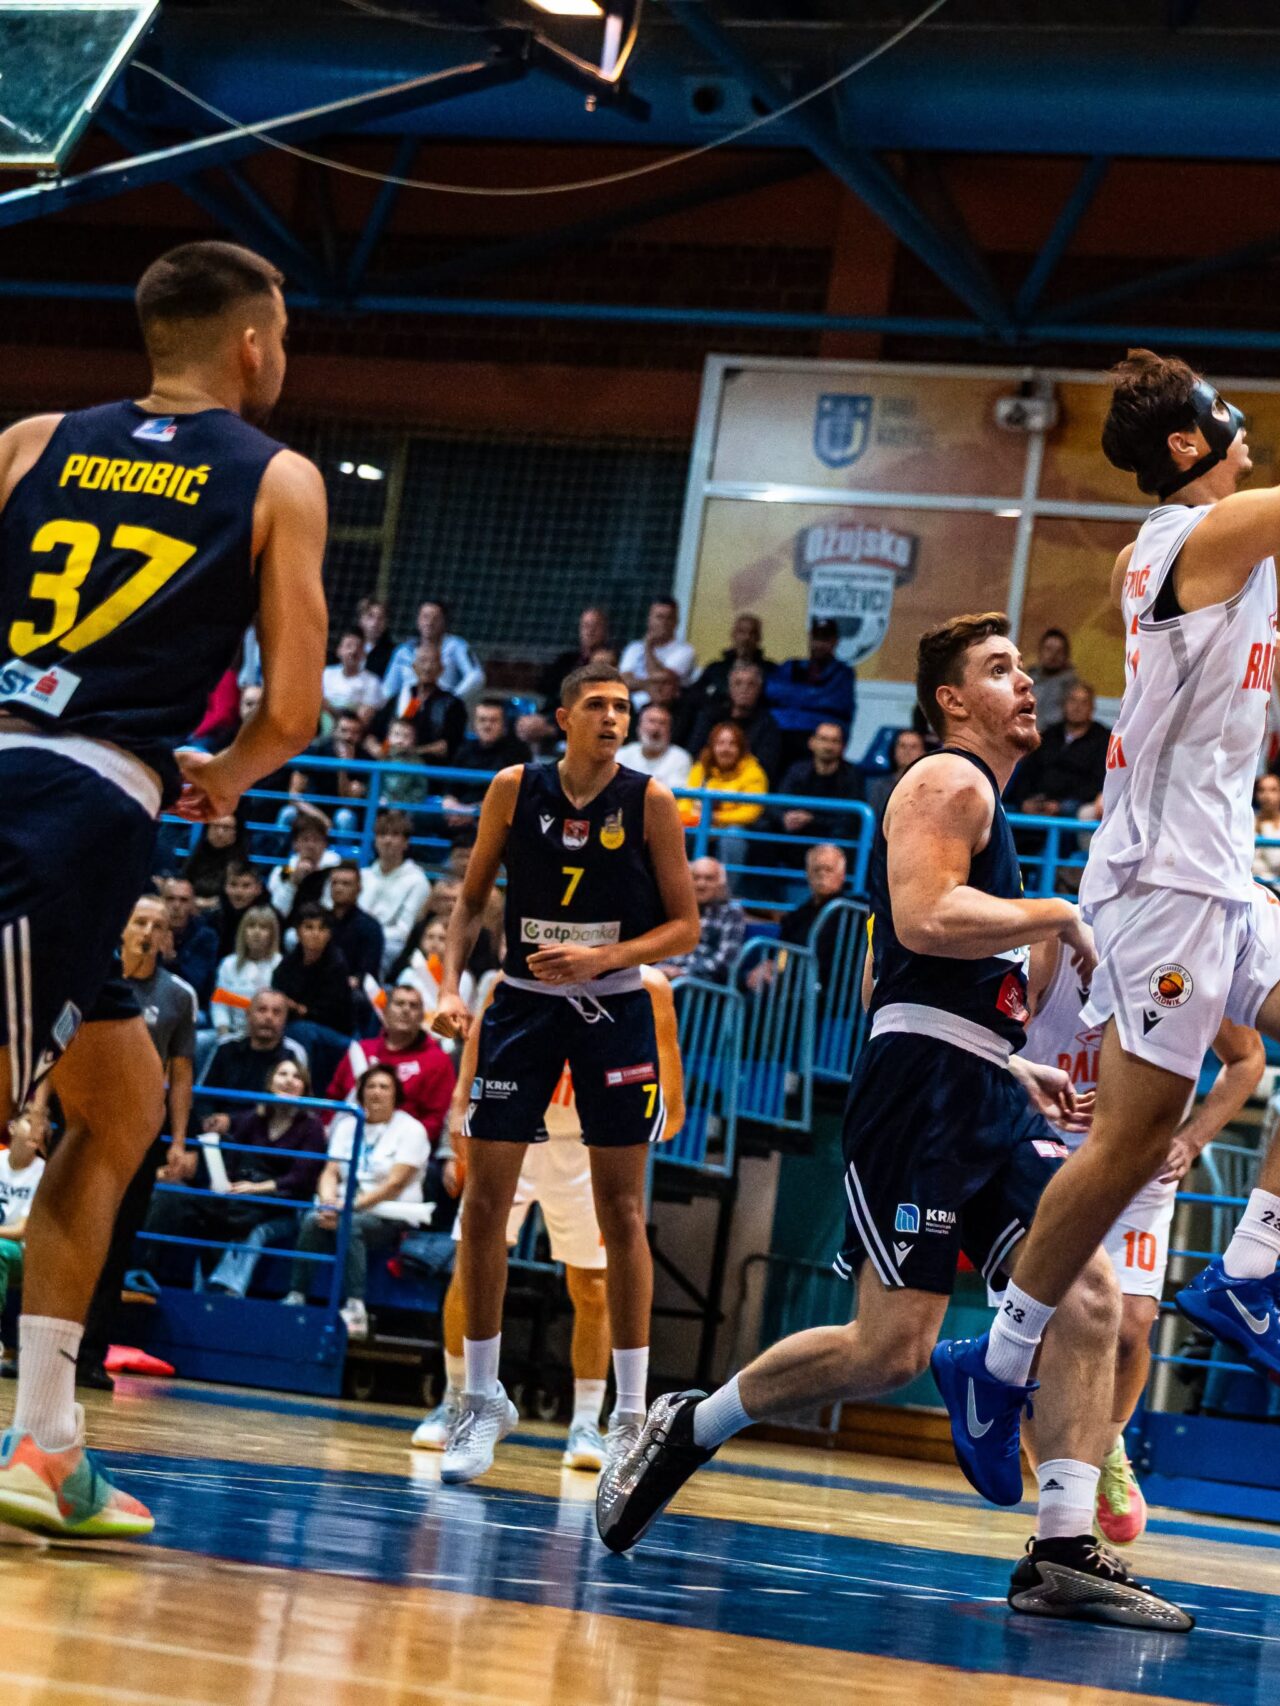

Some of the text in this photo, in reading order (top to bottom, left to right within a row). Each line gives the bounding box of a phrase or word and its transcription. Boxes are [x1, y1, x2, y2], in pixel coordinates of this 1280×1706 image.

[59, 453, 213, 505] POROBIĆ
[8, 518, 197, 657] 37
[560, 866, 585, 906] 7
[543, 924, 617, 944] otpbanka
[485, 1080, 518, 1091] KRKA
[642, 1083, 658, 1118] 7
[1122, 1231, 1157, 1272] 10
[1003, 1300, 1026, 1324] 23
